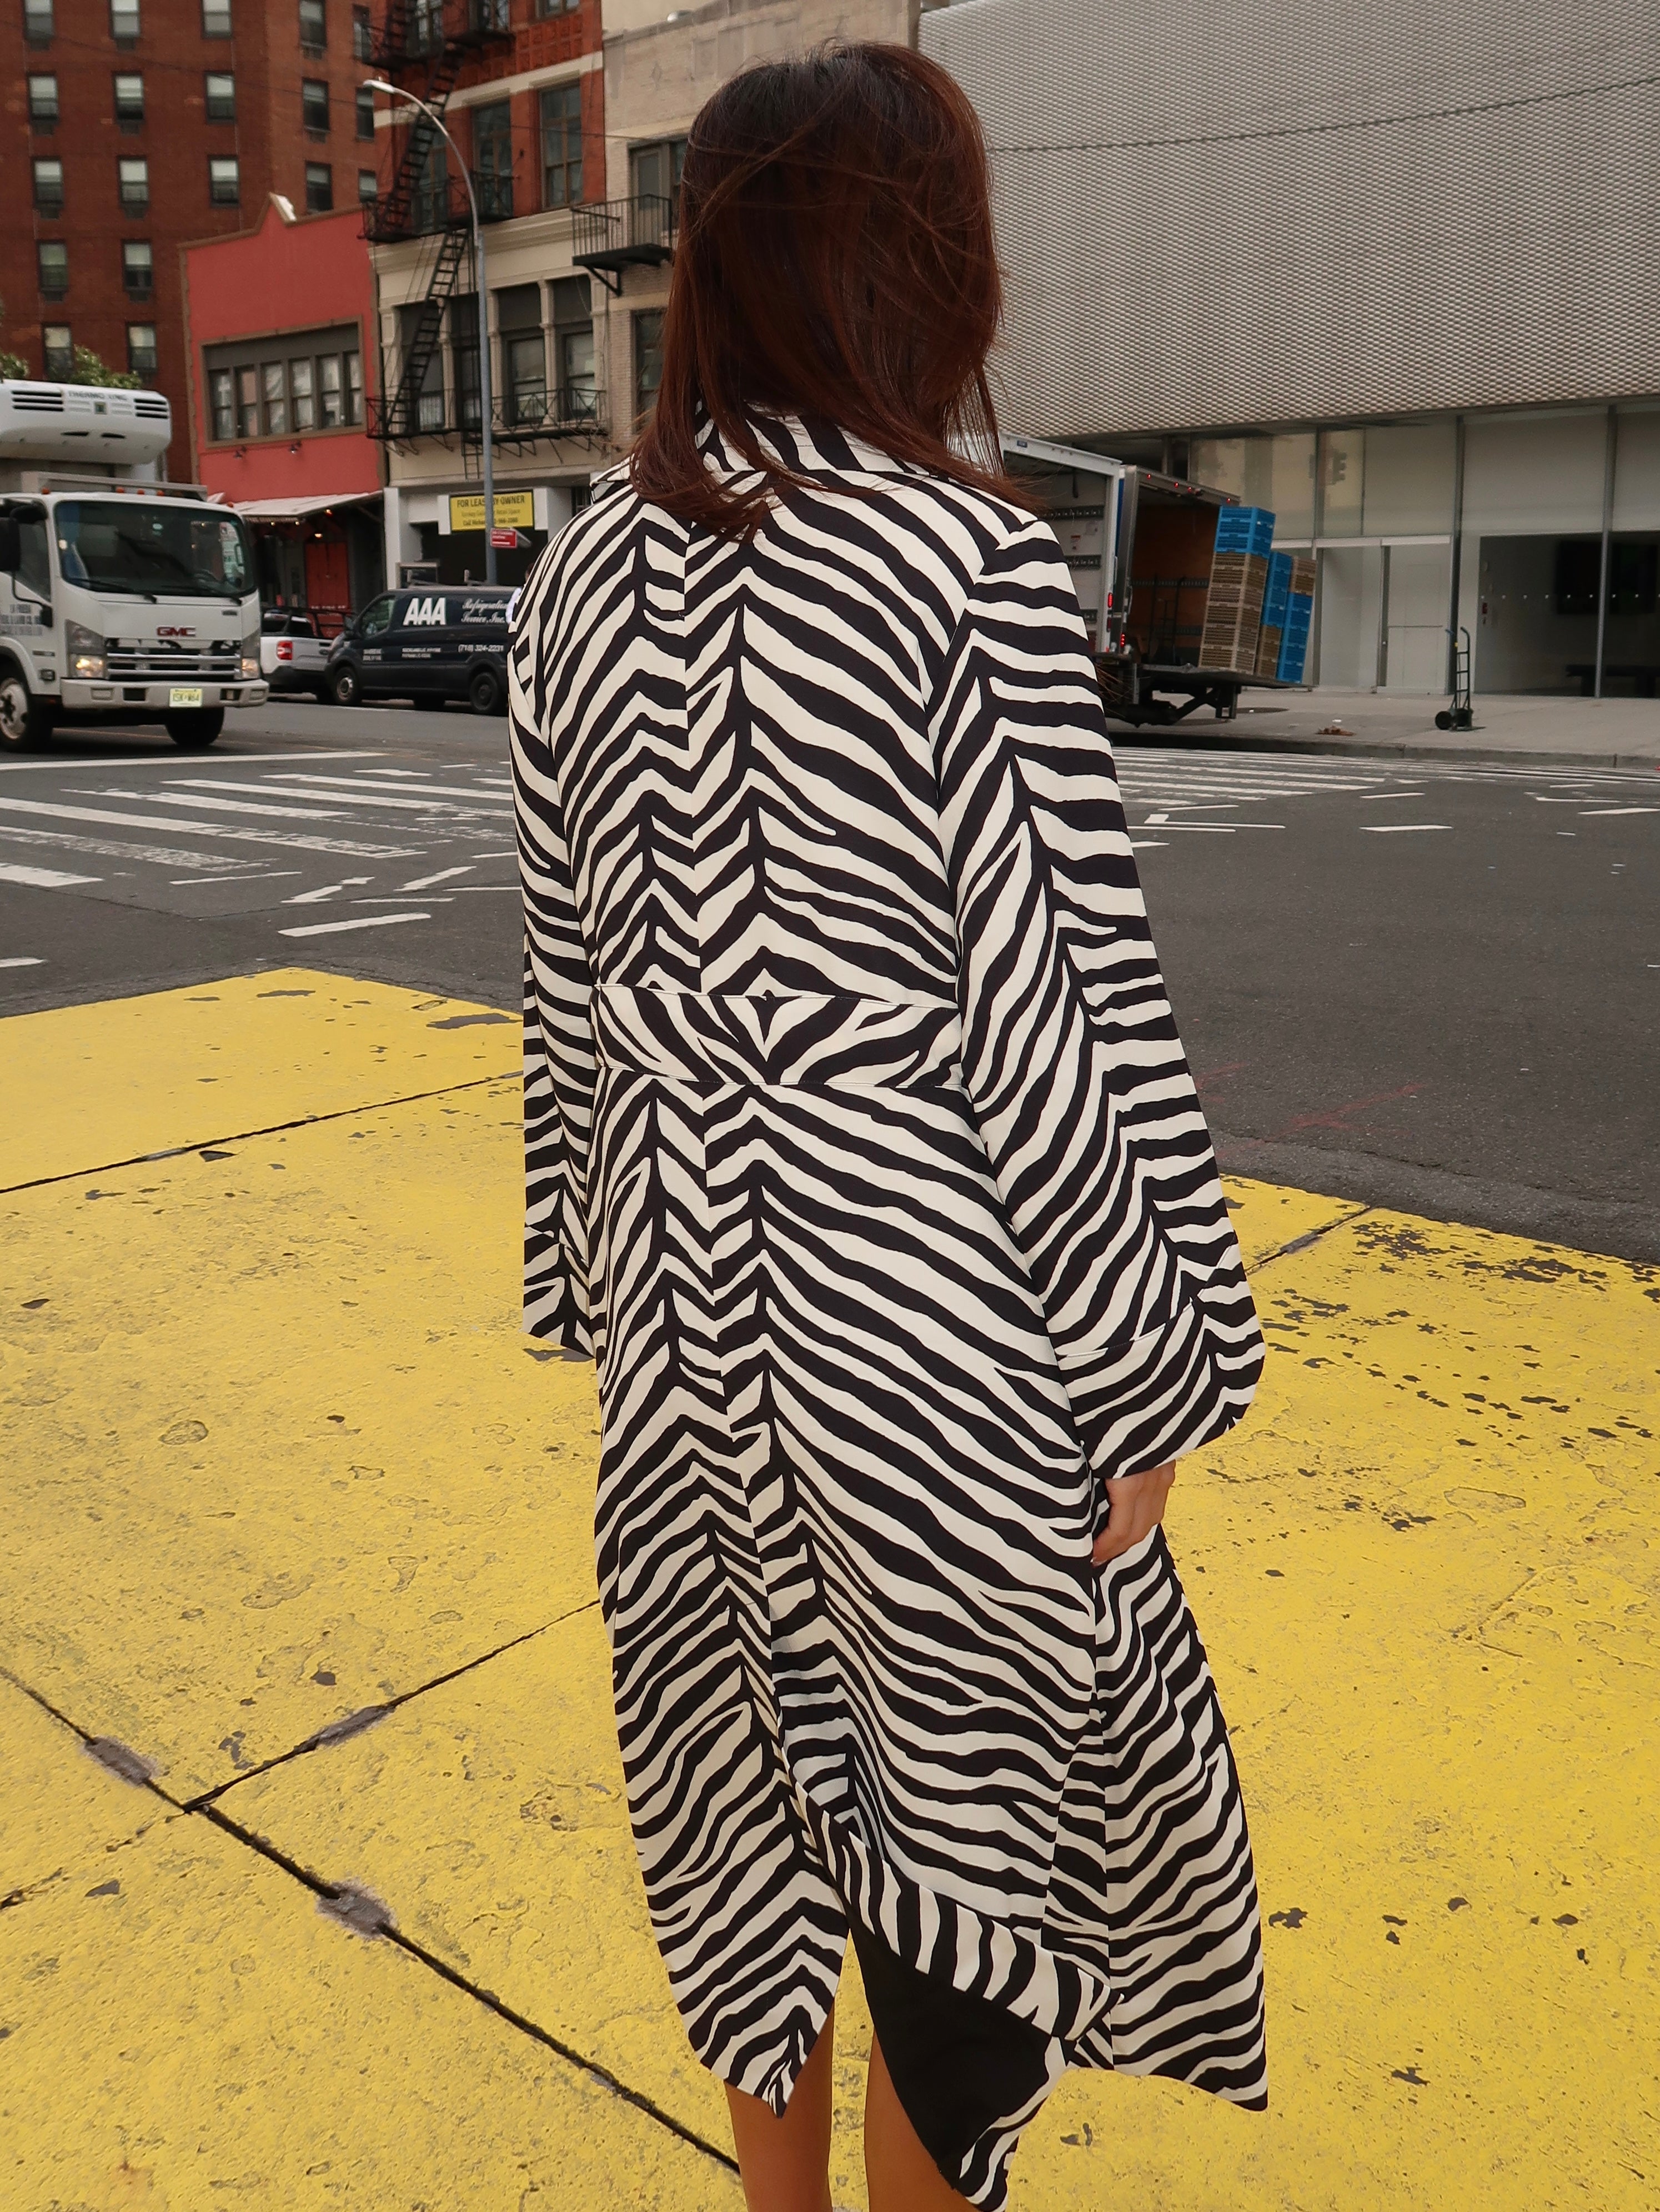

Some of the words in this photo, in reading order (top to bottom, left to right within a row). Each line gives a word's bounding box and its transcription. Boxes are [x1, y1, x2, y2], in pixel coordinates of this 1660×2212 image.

[457, 499, 469, 507] FOR
[470, 497, 486, 507] LEAS
[500, 495, 525, 505] OWNER
[403, 597, 447, 626] AAA
[156, 627, 195, 636] GMC
[458, 644, 473, 652] (718)
